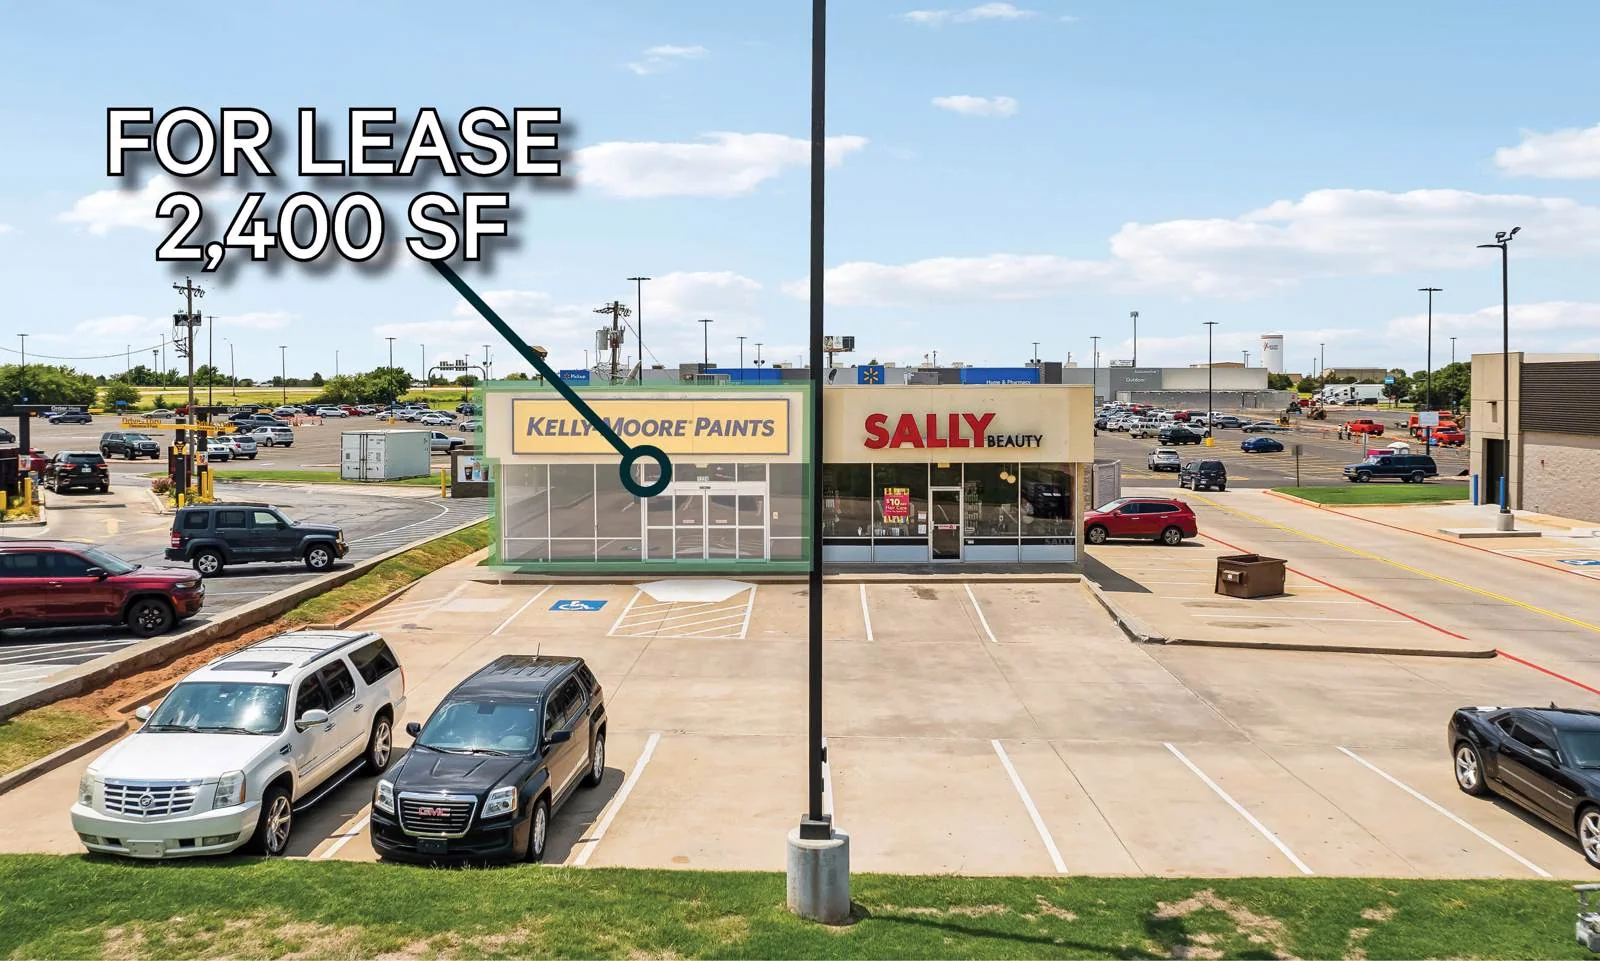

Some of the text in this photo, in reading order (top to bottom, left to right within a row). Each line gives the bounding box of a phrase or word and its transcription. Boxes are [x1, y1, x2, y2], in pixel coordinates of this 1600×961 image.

[694, 416, 775, 437] PAINTS
[864, 413, 1043, 449] SALLY BEAUTY
[418, 807, 451, 816] GMC
